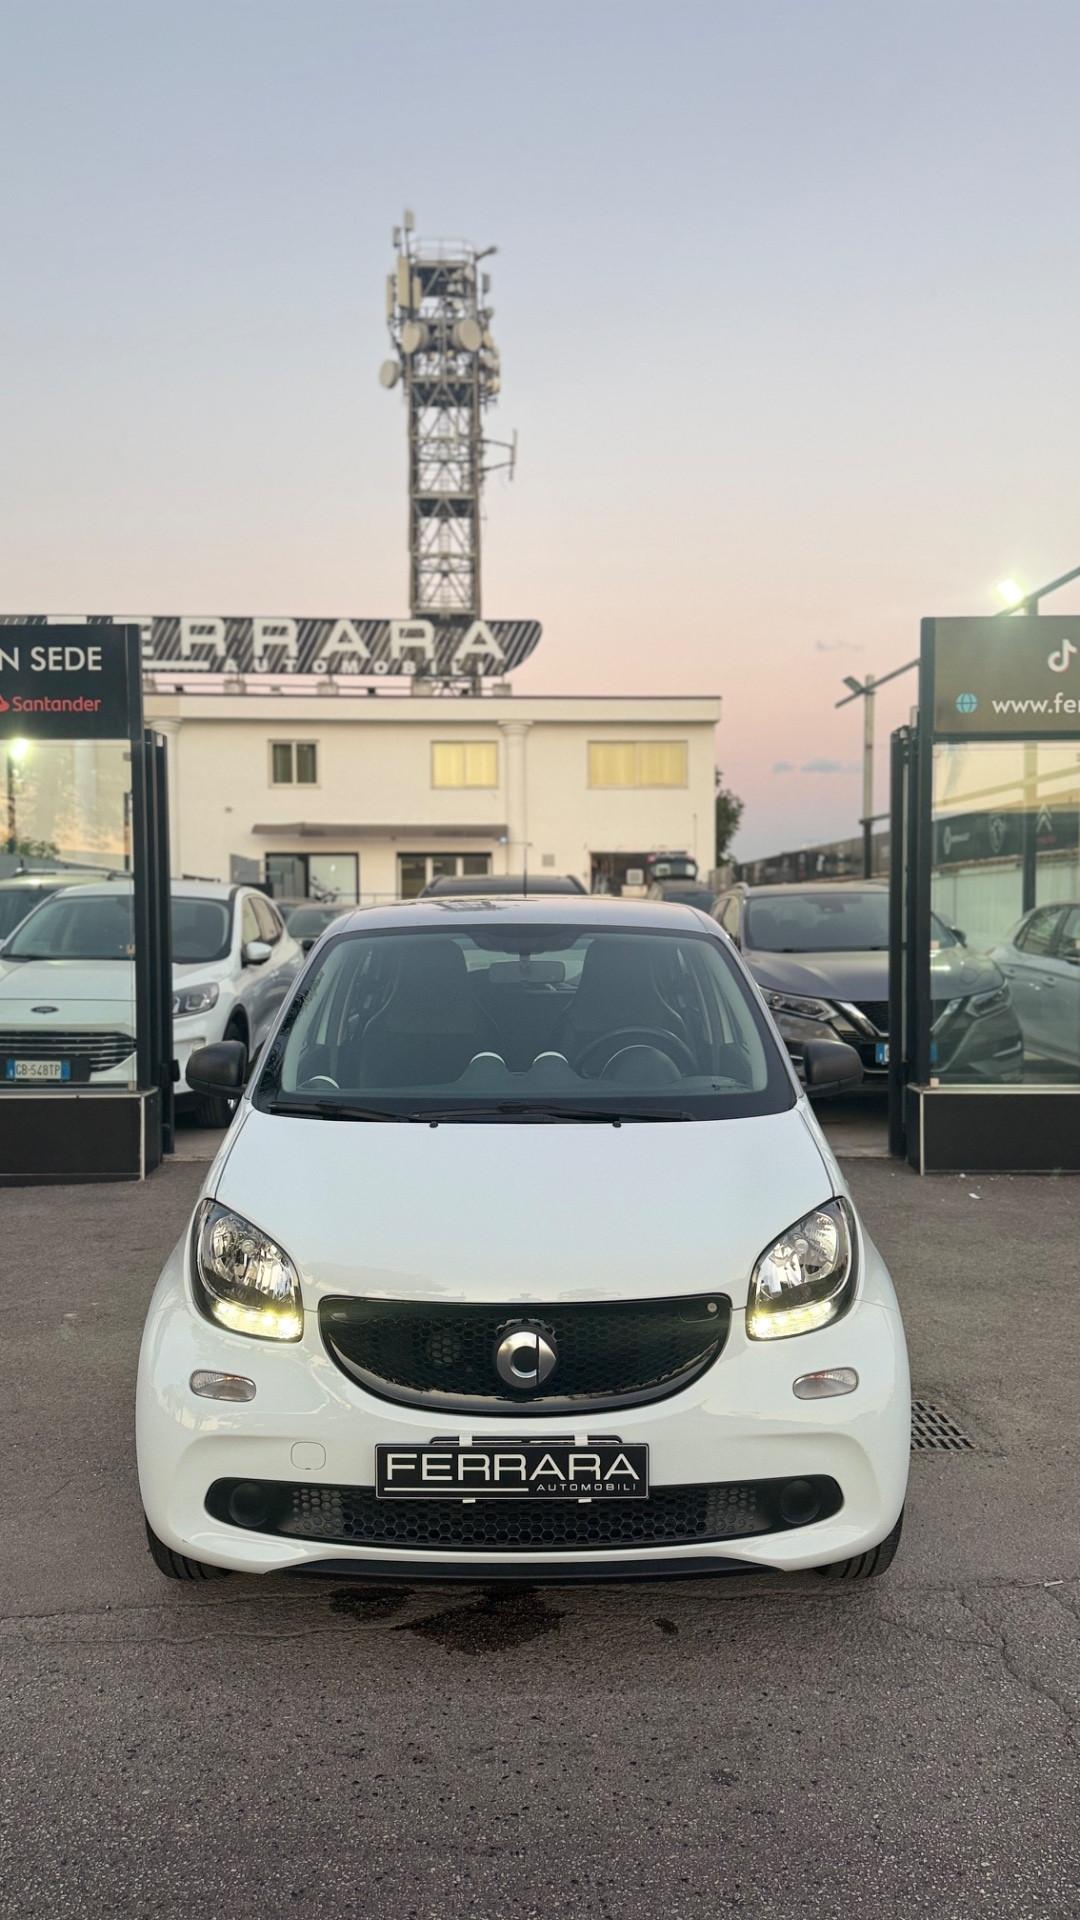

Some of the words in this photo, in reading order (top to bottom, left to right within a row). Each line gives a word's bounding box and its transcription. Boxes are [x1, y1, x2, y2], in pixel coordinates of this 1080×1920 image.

[31, 646, 102, 671] SEDE
[223, 659, 486, 674] AUTOMOBILI
[12, 697, 101, 711] Santander
[991, 692, 1080, 714] www.fe
[387, 1453, 640, 1481] FERRARA
[536, 1483, 637, 1492] AUTOMOBILI
